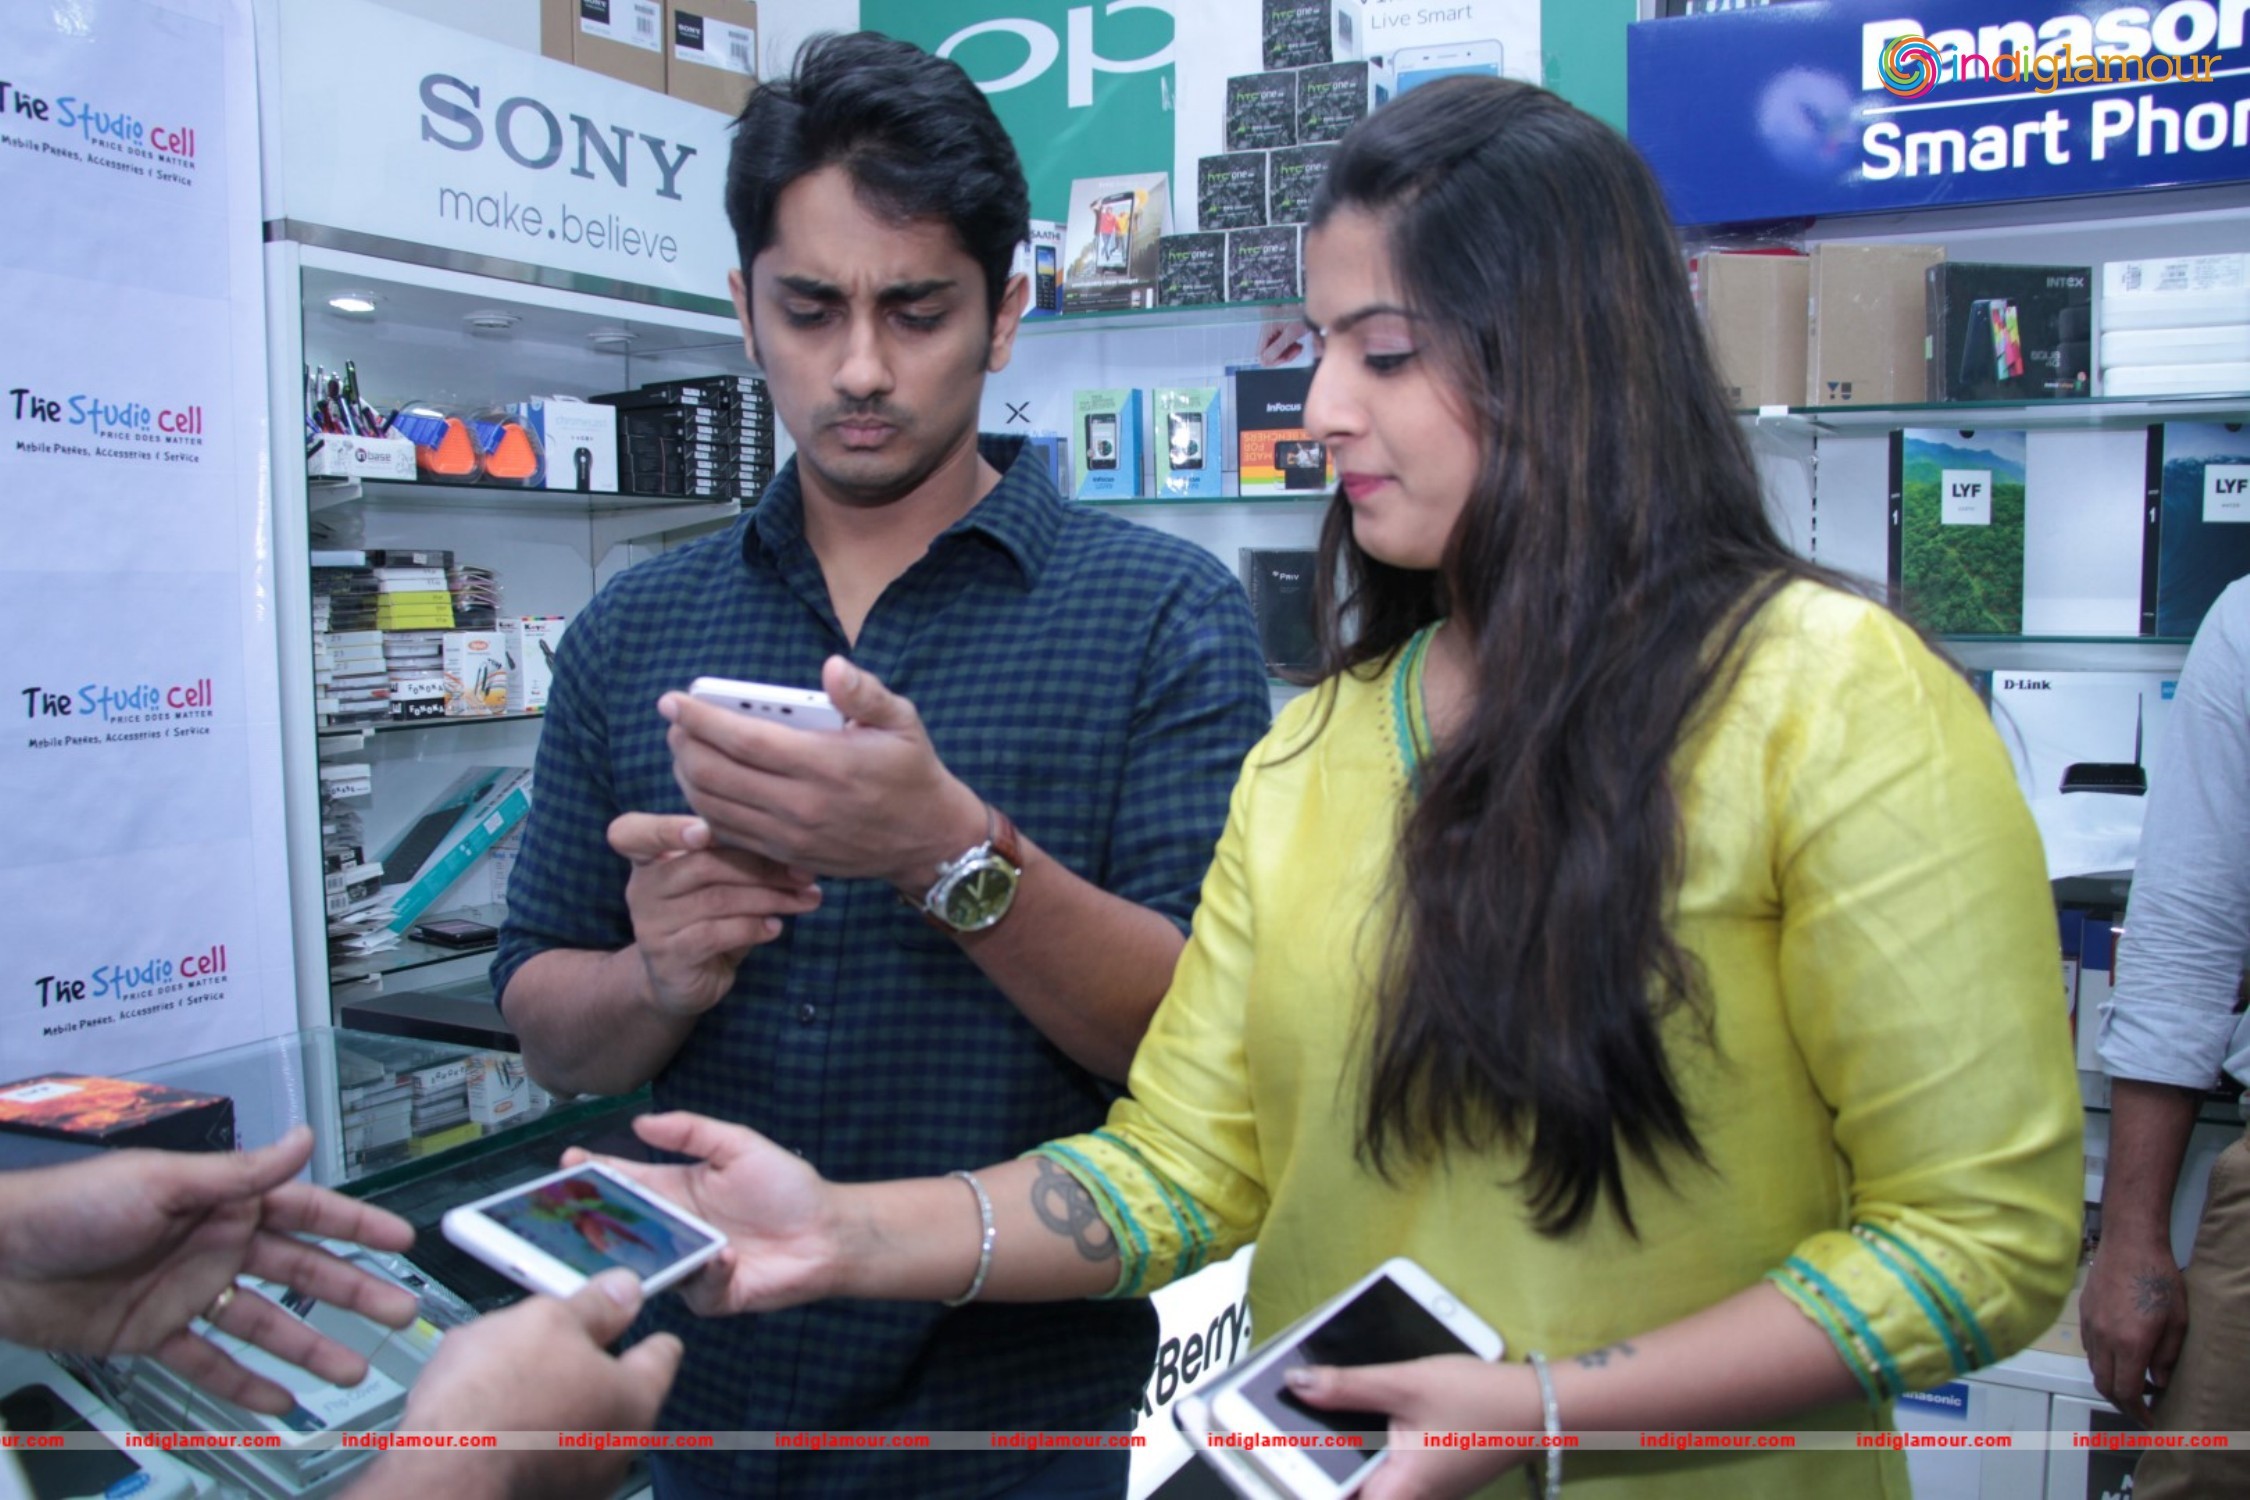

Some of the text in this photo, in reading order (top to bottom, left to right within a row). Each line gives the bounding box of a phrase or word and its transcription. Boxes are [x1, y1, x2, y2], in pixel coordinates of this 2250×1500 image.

[1372, 5, 1473, 29] Live Smart
[0, 81, 49, 121] The
[57, 96, 143, 145] Studio
[92, 137, 195, 170] PRICE DOES MATTER
[419, 73, 698, 201] SONY
[1862, 109, 2070, 180] Smart
[1, 134, 40, 151] Mobile
[156, 169, 192, 187] Service
[439, 186, 678, 263] make.believe
[9, 388, 62, 422] The
[68, 395, 151, 434] Studio
[16, 441, 51, 453] Mobile
[164, 451, 200, 463] Service
[100, 431, 203, 446] PRICE DOES MATTER
[1952, 483, 1982, 498] LYF
[2216, 479, 2249, 494] LYF
[2004, 678, 2052, 690] D-Link
[22, 686, 72, 718] The
[78, 684, 160, 721] Studio
[110, 710, 213, 724] PRICE DOES MATTER
[28, 738, 62, 748] Mobile
[173, 726, 210, 737] Service
[35, 975, 86, 1008] The
[92, 959, 173, 1000] Studio
[122, 975, 228, 1001] PRICE DOES MATTER
[43, 1022, 77, 1036] Mobile
[187, 992, 225, 1006] Service
